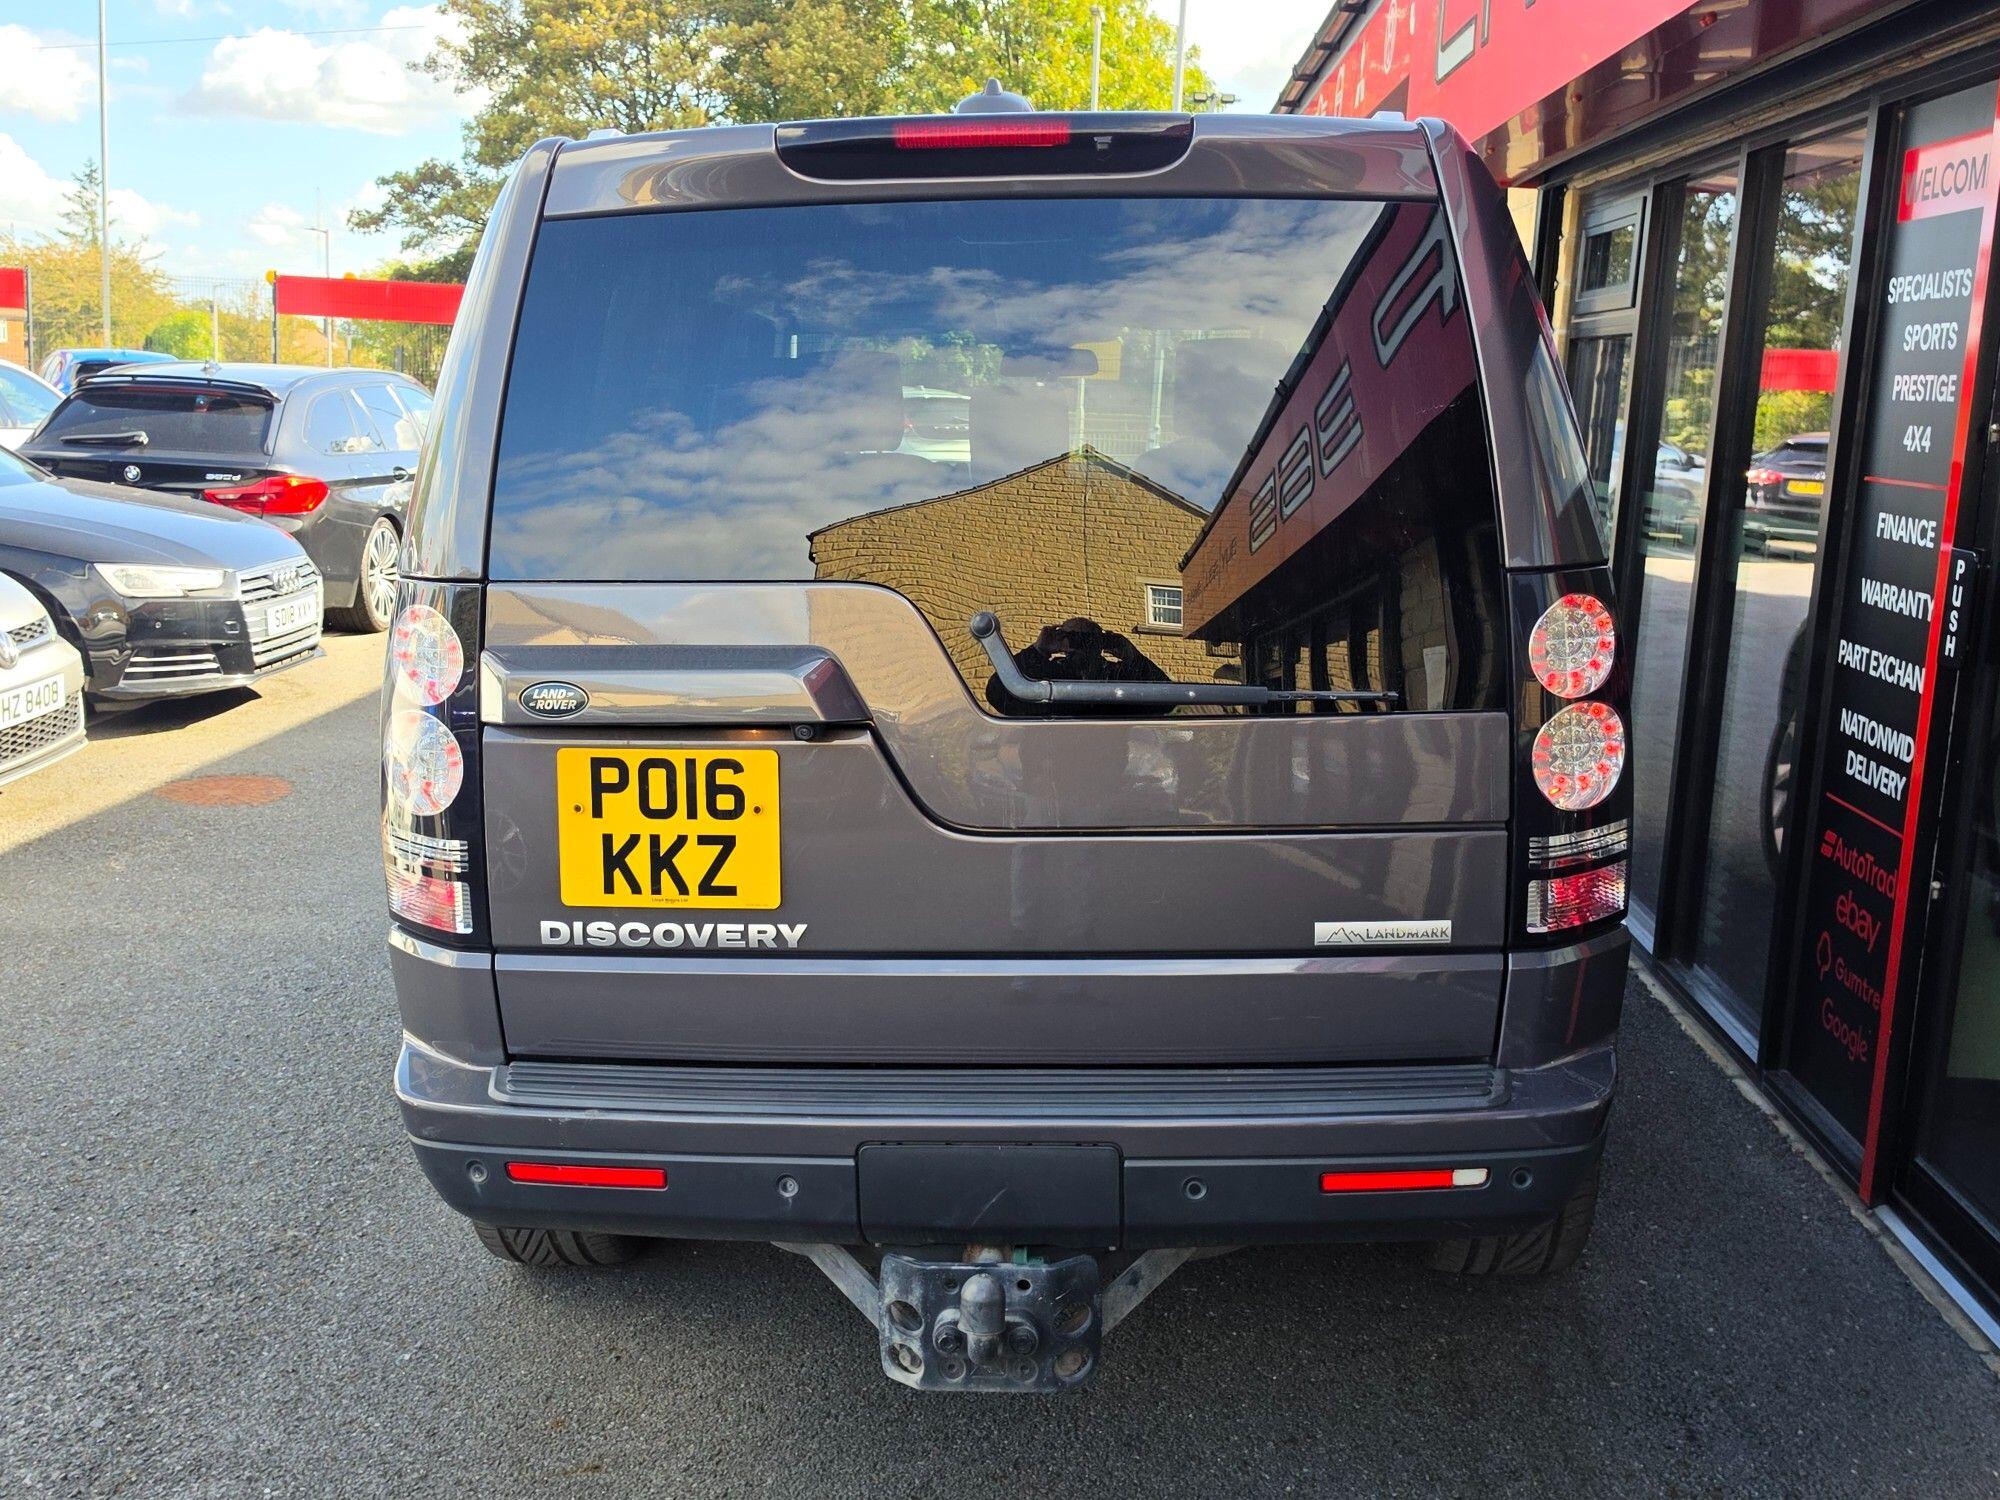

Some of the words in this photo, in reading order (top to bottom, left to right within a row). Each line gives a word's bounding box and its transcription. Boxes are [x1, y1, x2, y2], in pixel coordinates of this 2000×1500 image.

[1905, 153, 1991, 206] WELCOM
[1888, 268, 1973, 304] SPECIALISTS
[1903, 322, 1958, 351] SPORTS
[1892, 374, 1957, 402] PRESTIGE
[1903, 425, 1931, 453] 4X4
[1876, 512, 1936, 549] FINANCE
[1861, 577, 1935, 622] WARRANTY
[1945, 559, 1965, 658] PUSH
[1838, 639, 1870, 673] PART
[1869, 650, 1926, 694] EXCHAN
[26, 681, 58, 713] 8408
[533, 689, 566, 699] LAND
[536, 700, 577, 710] ROVER
[1840, 708, 1914, 763] NATIONWID
[590, 757, 745, 820] PO16
[1846, 750, 1906, 801] DELIVERY
[602, 833, 737, 896] KKZ
[1833, 838, 1898, 898] AutoTrad
[540, 920, 808, 948] DISCOVERY
[1366, 926, 1449, 939] LANDMARK
[1836, 890, 1881, 952] ebay
[1835, 957, 1880, 1010] Gumtre
[1822, 998, 1868, 1061] Google
